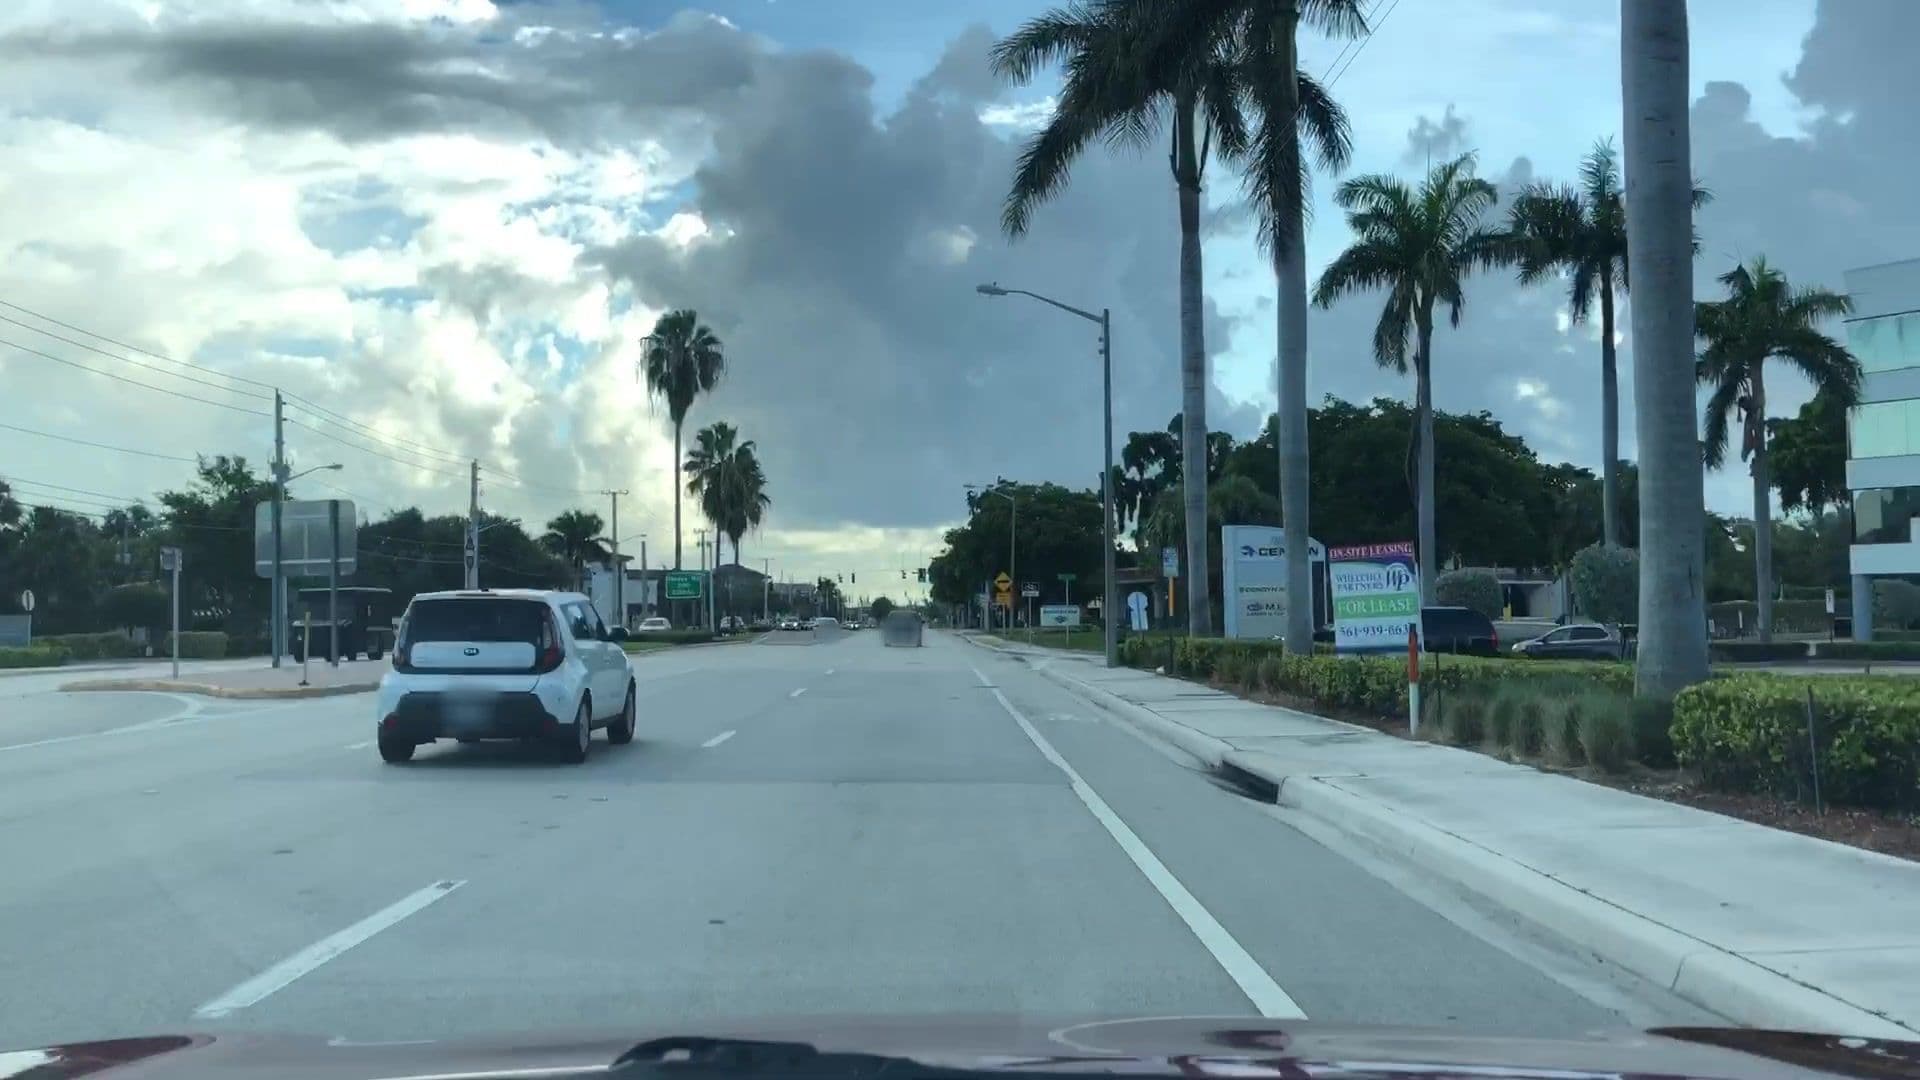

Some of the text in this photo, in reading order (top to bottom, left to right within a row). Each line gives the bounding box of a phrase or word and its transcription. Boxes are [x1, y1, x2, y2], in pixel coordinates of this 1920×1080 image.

[1329, 543, 1412, 560] ON-SITE LEASING
[1336, 582, 1384, 592] PARTNERS
[1337, 598, 1412, 614] FOR LEASE
